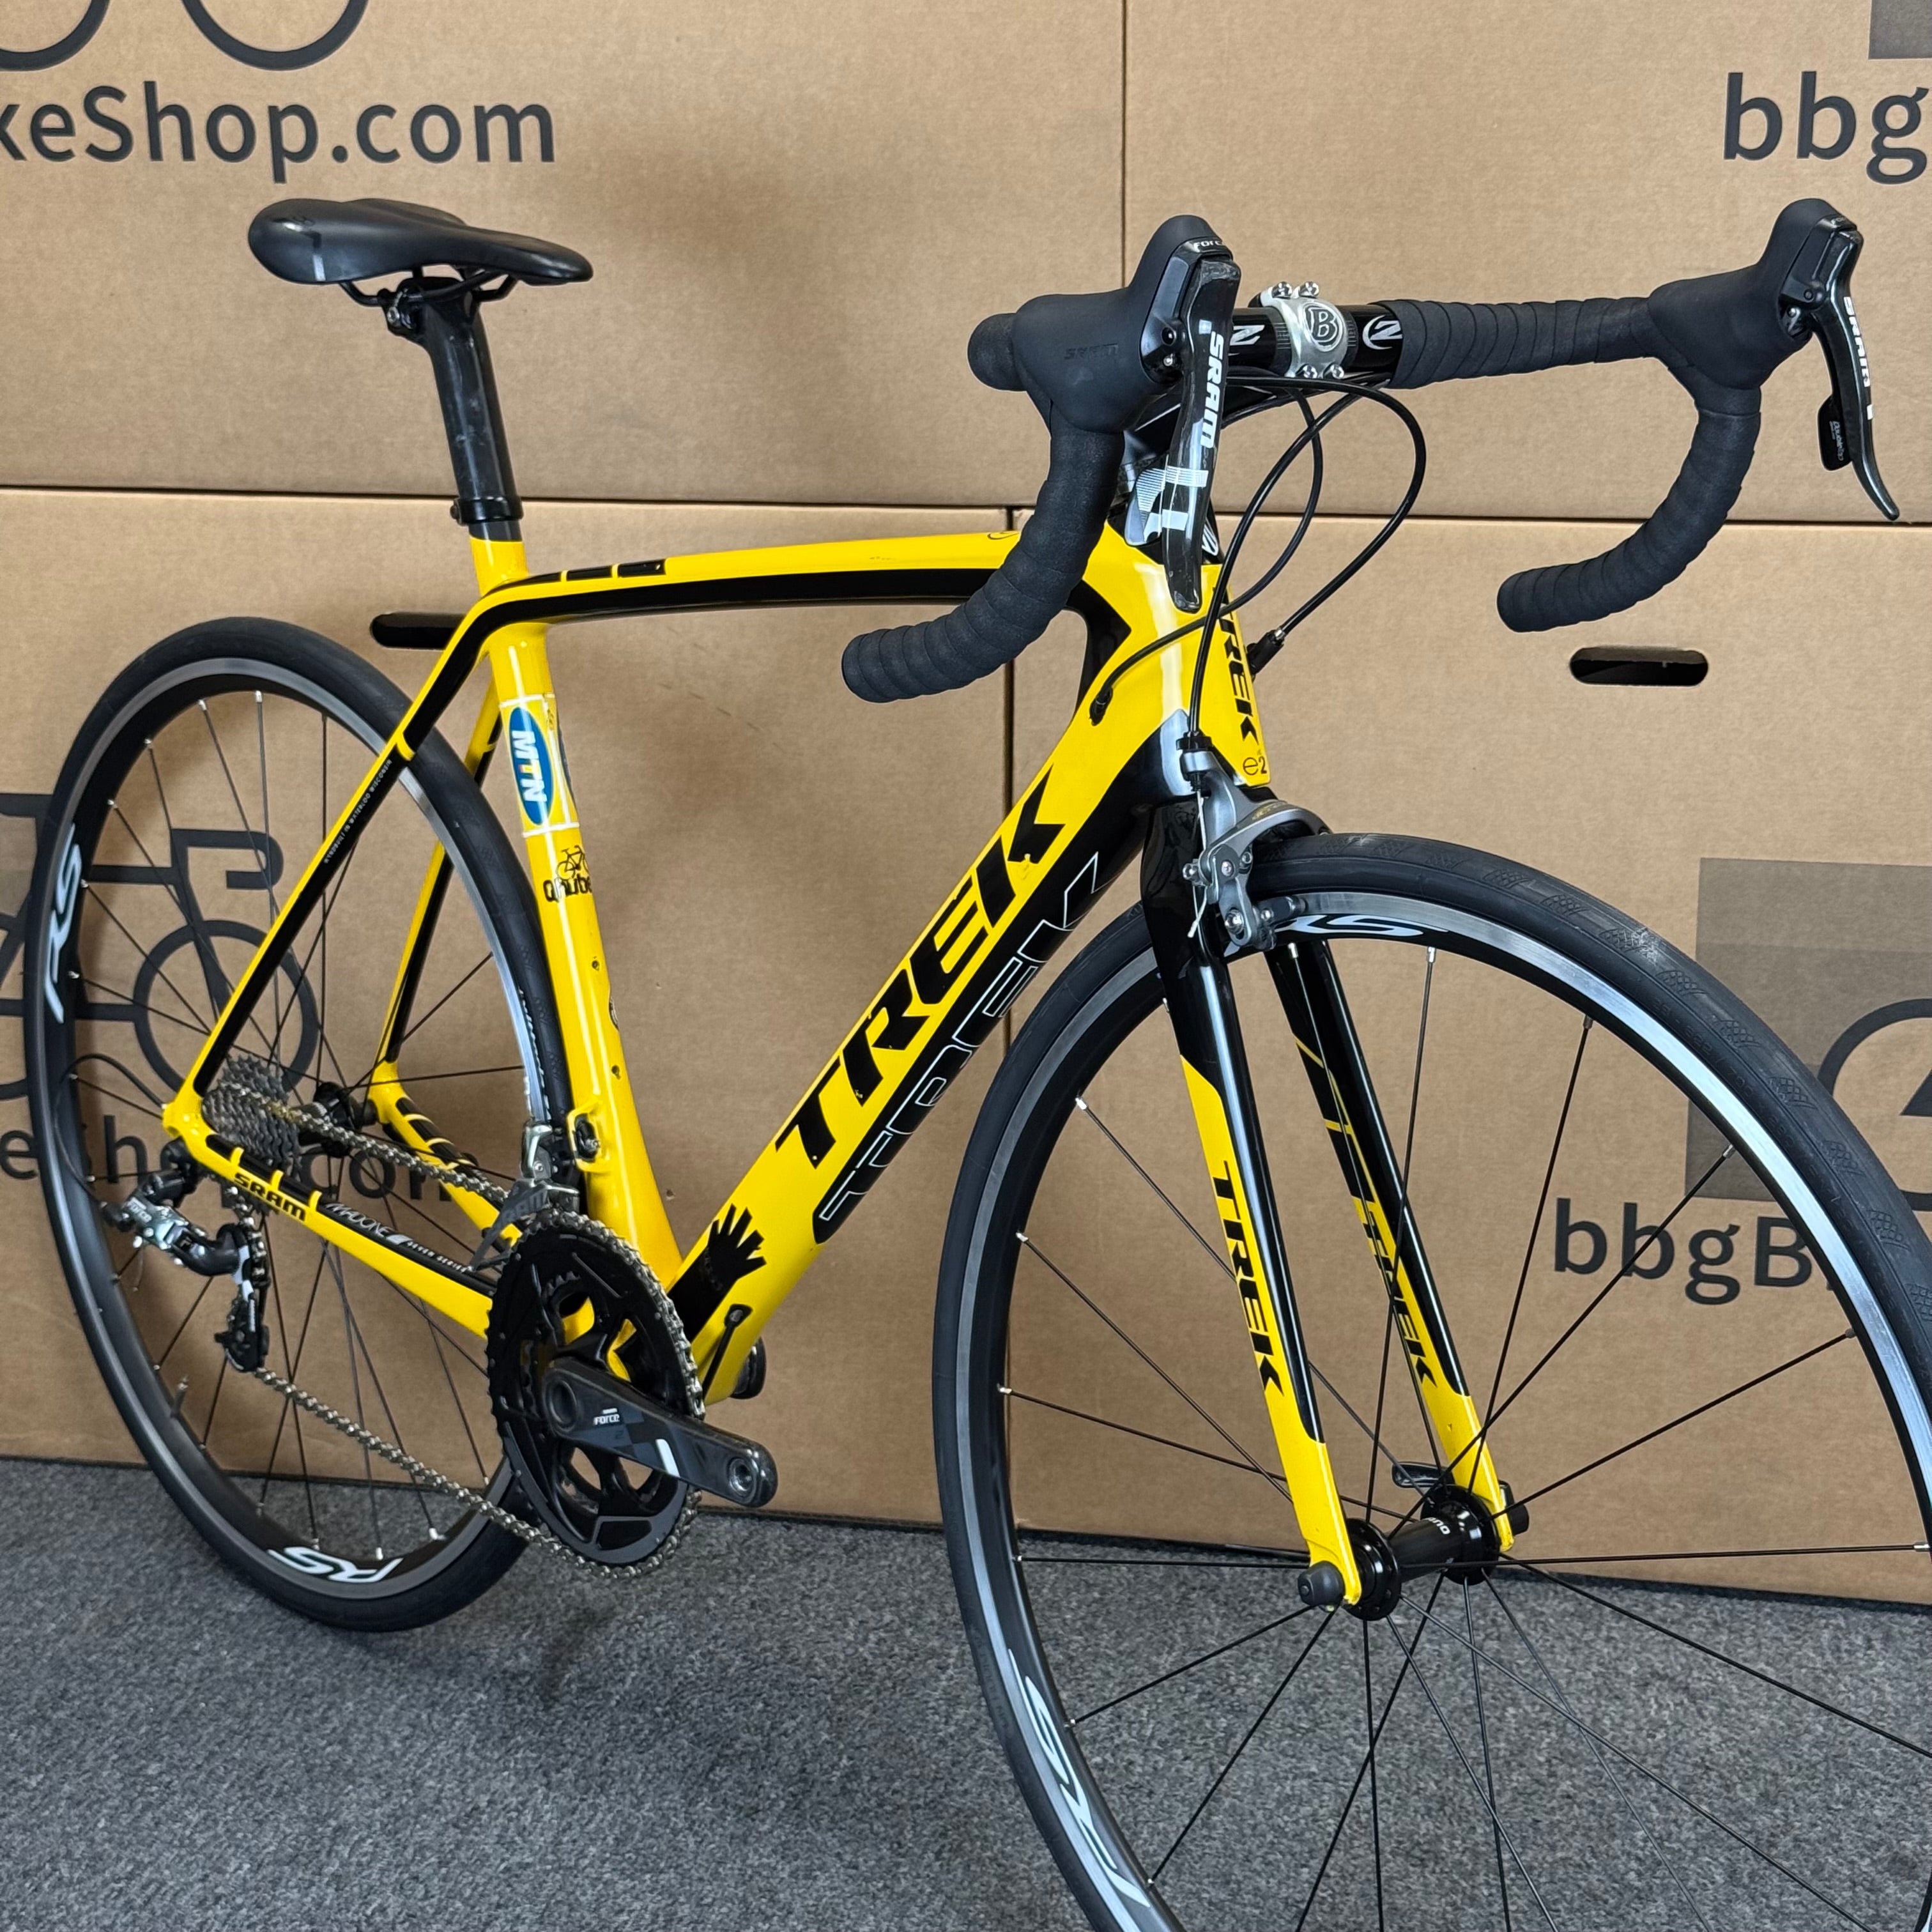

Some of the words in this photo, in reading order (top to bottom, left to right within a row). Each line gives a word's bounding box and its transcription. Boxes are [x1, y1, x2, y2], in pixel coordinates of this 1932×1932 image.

[1200, 330, 1225, 448] SRAM
[511, 730, 548, 803] MTN
[774, 762, 1066, 1169] TREK
[235, 1171, 307, 1222] SRAM
[1554, 1197, 1832, 1305] bbgB
[1213, 1160, 1285, 1397] TREK
